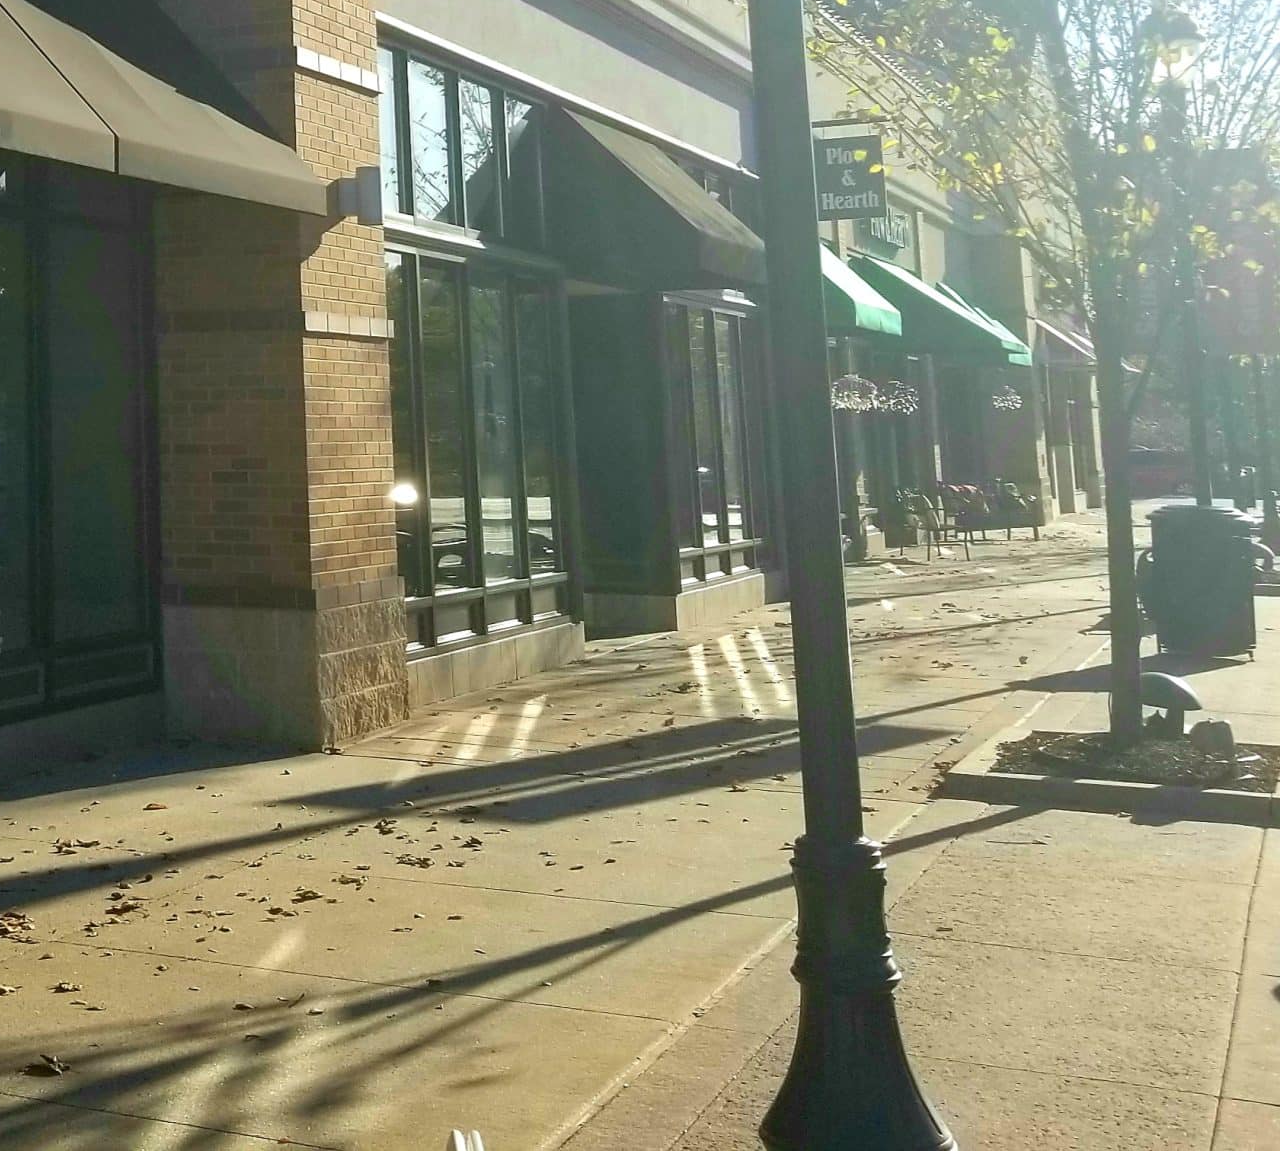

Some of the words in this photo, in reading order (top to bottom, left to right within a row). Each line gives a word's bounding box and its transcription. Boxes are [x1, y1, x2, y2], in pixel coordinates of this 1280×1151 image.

[825, 147, 867, 165] Plo
[841, 169, 857, 186] &
[821, 190, 880, 210] Hearth
